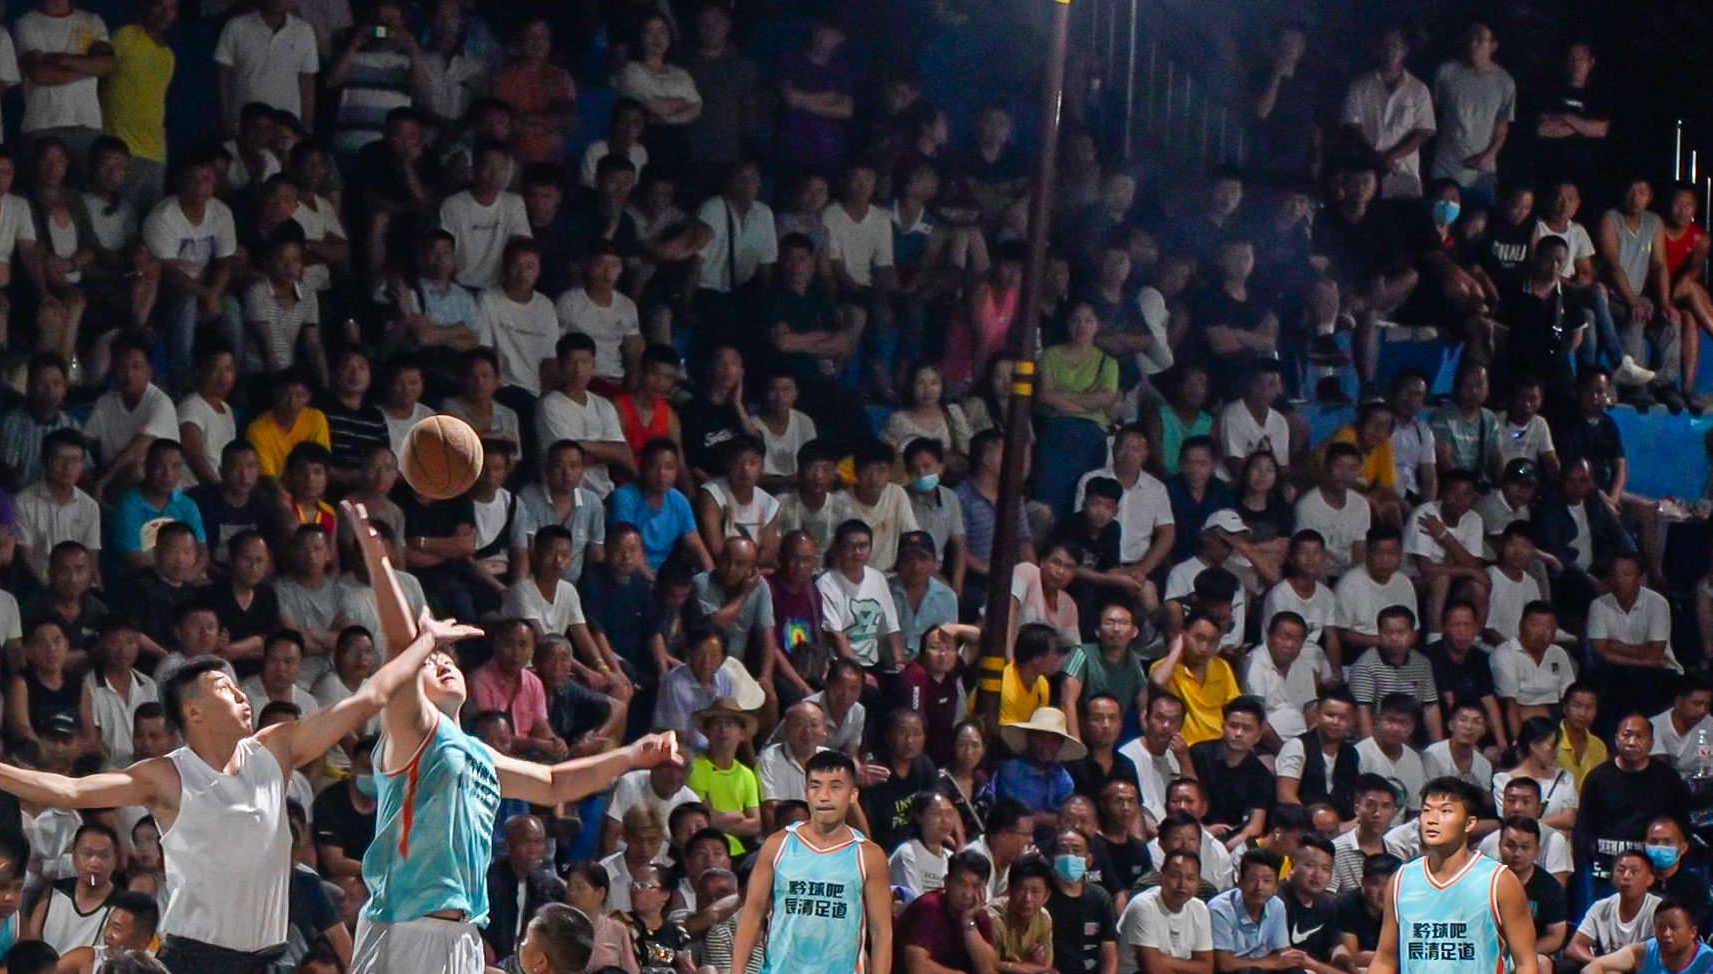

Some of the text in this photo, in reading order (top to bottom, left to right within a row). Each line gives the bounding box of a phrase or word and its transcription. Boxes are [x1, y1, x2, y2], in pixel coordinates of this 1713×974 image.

[789, 881, 845, 899] 黔球吧
[1412, 922, 1468, 939] 黔球吧
[1407, 942, 1476, 961] 辰清足道
